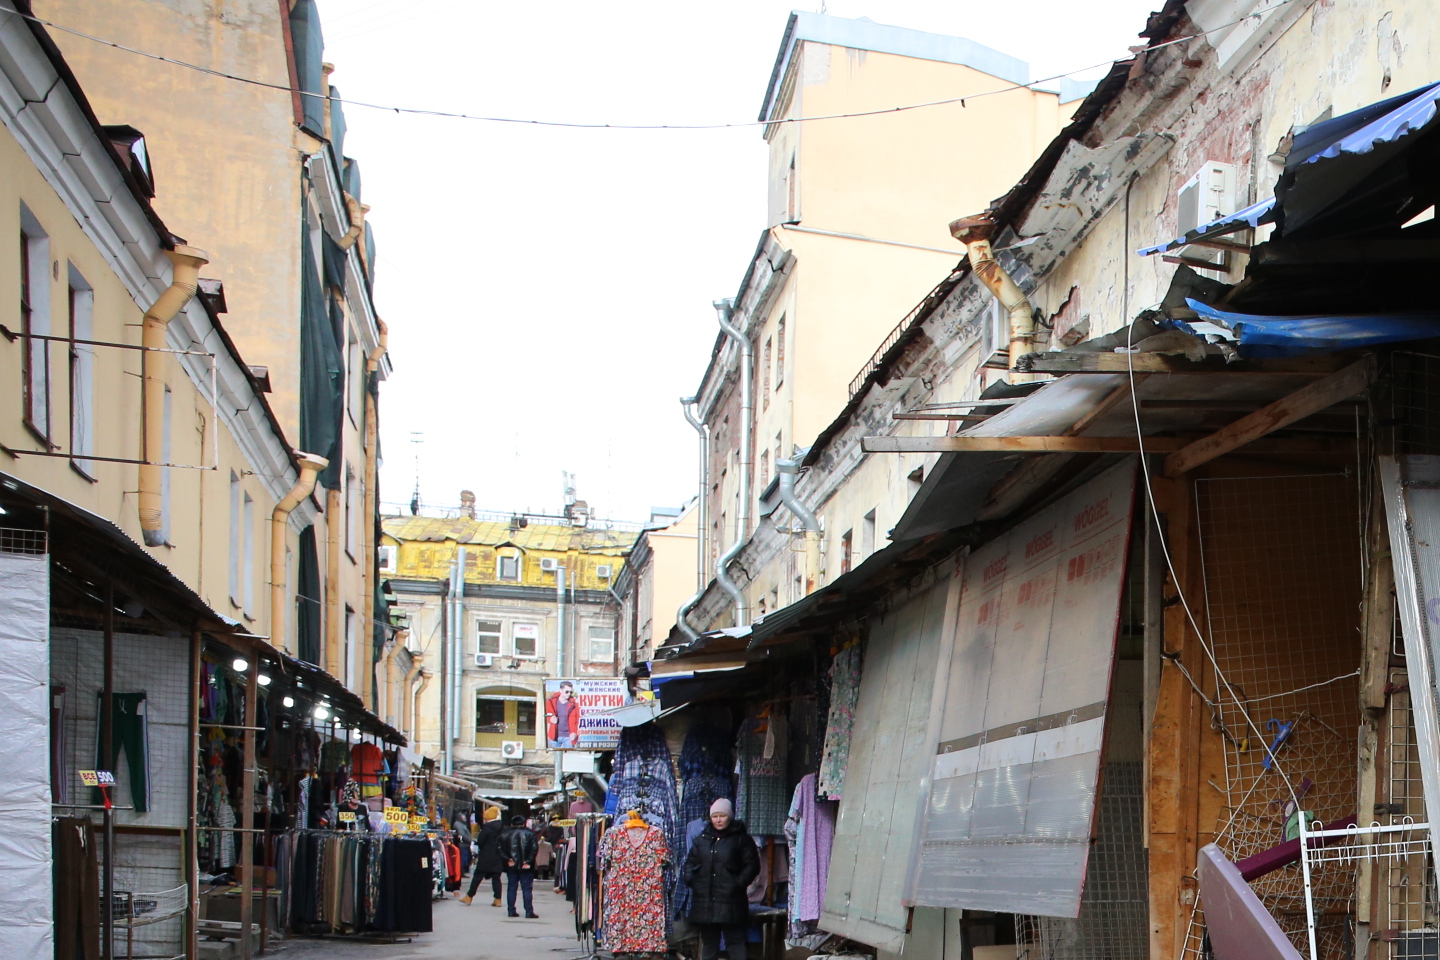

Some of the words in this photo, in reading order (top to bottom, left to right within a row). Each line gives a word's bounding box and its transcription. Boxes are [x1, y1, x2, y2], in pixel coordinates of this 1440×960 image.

[1074, 497, 1110, 532] WÖGGEL
[580, 695, 624, 706] КУРТКИ
[97, 771, 114, 783] 500
[340, 812, 355, 820] 350
[386, 812, 407, 822] 500
